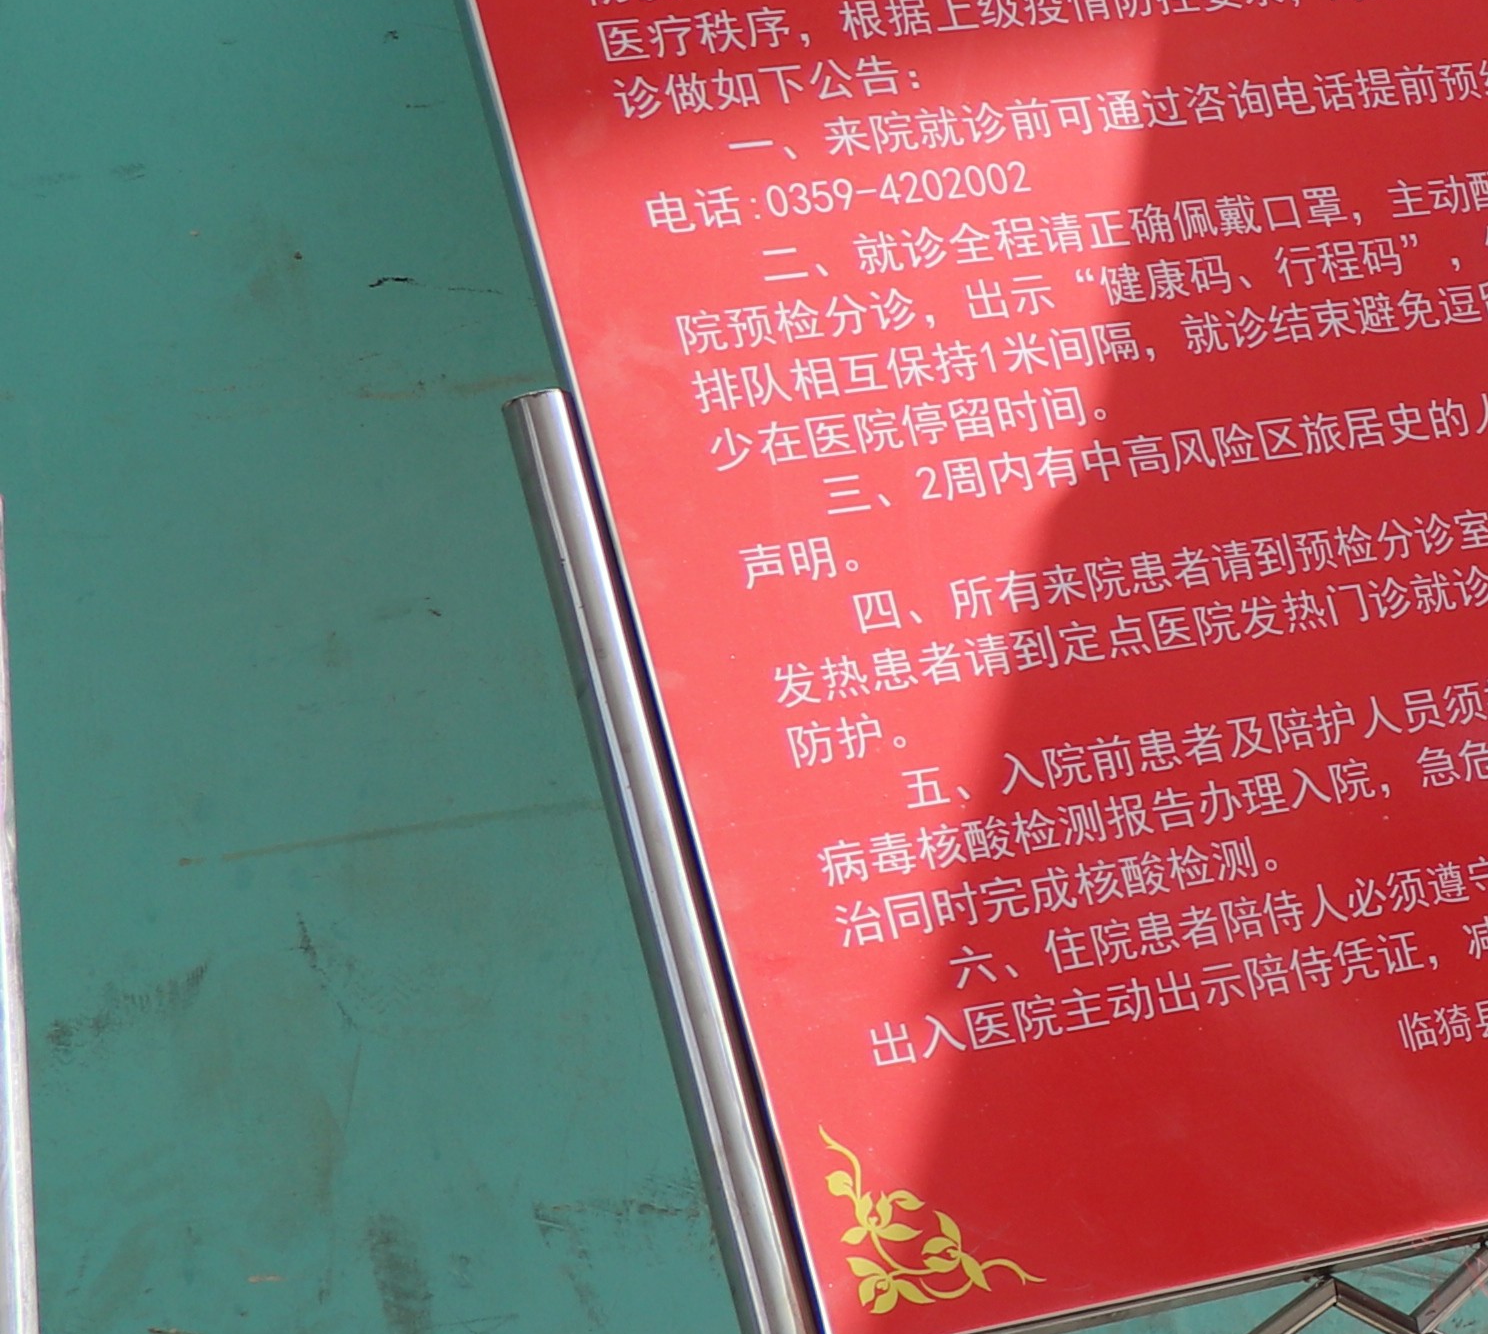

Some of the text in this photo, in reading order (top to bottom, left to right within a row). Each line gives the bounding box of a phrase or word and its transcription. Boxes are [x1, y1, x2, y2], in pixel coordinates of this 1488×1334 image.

[614, 55, 920, 119] 诊做如下公告：
[645, 161, 1031, 233] 电话:0359-4202002
[711, 386, 1106, 471] 少在医院停留时间。
[739, 537, 858, 589] 声明。
[786, 713, 906, 768] 防护。
[836, 836, 1277, 947] 治同时完成核酸检测。
